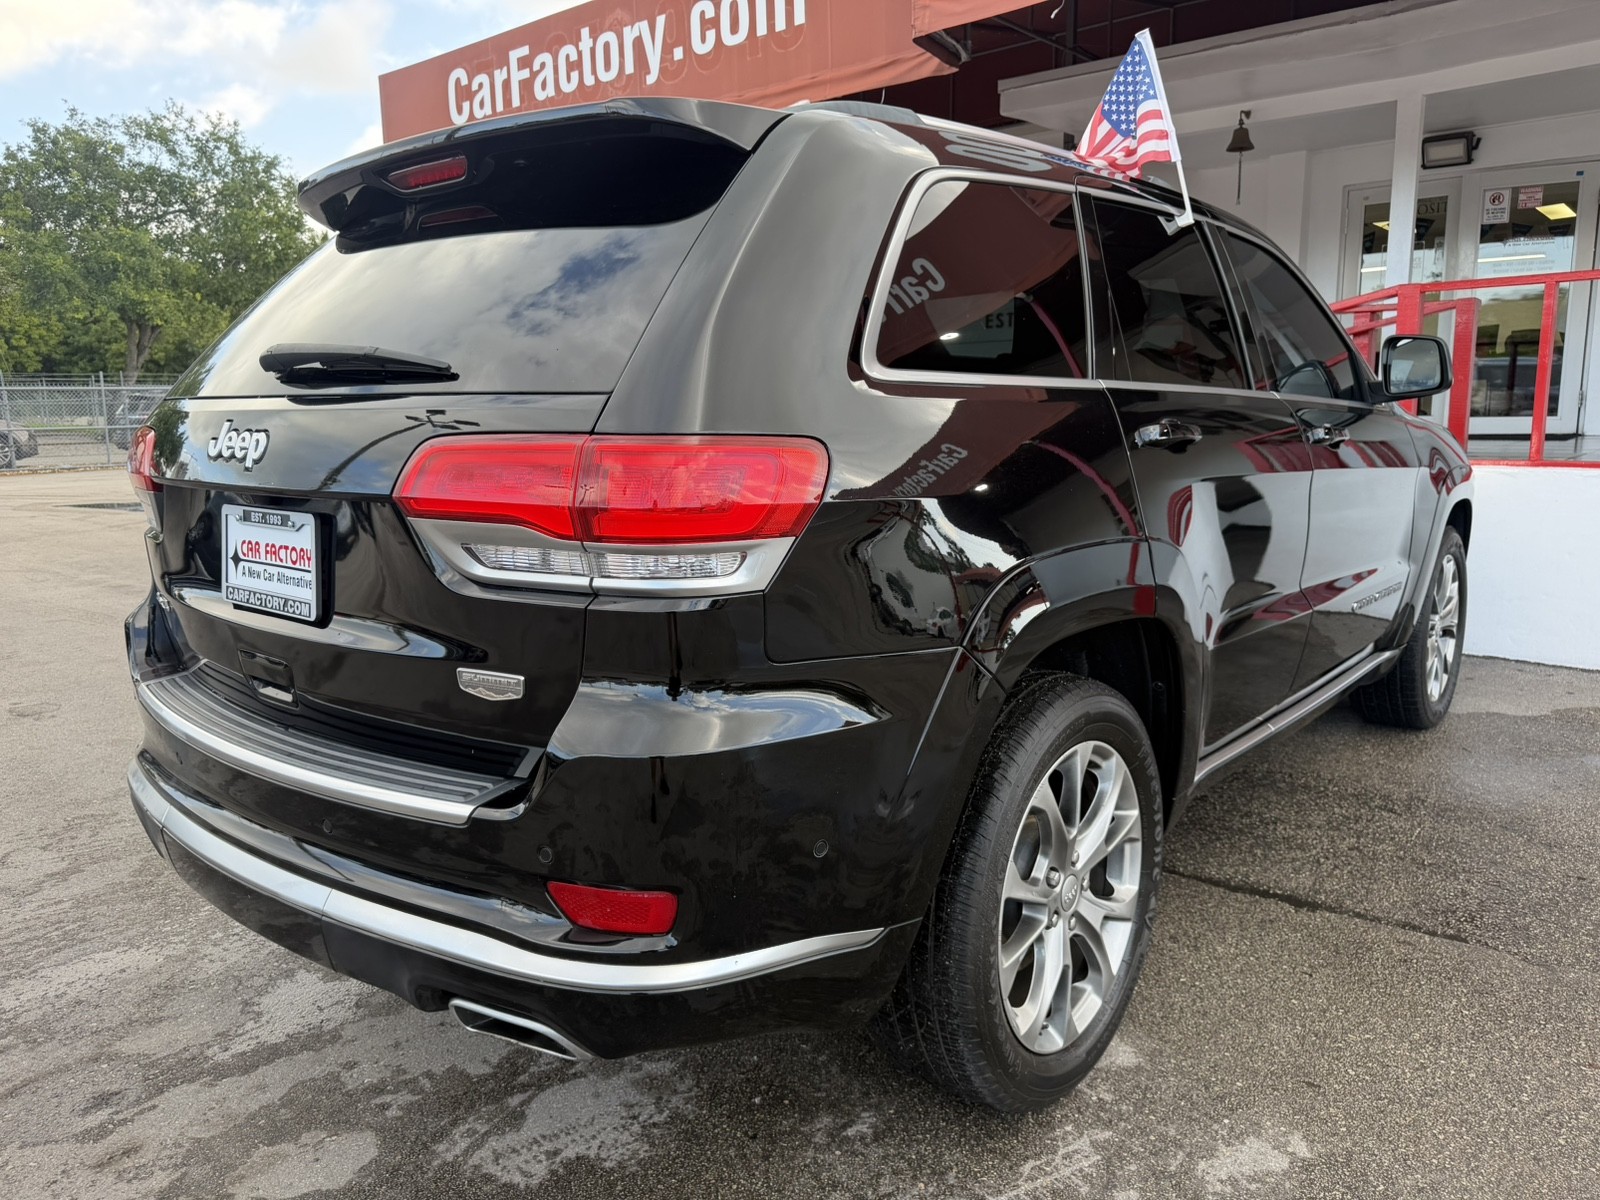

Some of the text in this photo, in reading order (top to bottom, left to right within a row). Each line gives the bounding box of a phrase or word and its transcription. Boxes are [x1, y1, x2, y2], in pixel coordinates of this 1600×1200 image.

[448, 0, 807, 125] CarFactory.com
[207, 419, 269, 471] Jeep
[251, 511, 282, 525] EST. 1993
[241, 539, 311, 568] CAR FACTORY
[242, 565, 312, 590] A New Car Alternative
[227, 587, 310, 617] CARFACTORY.COM
